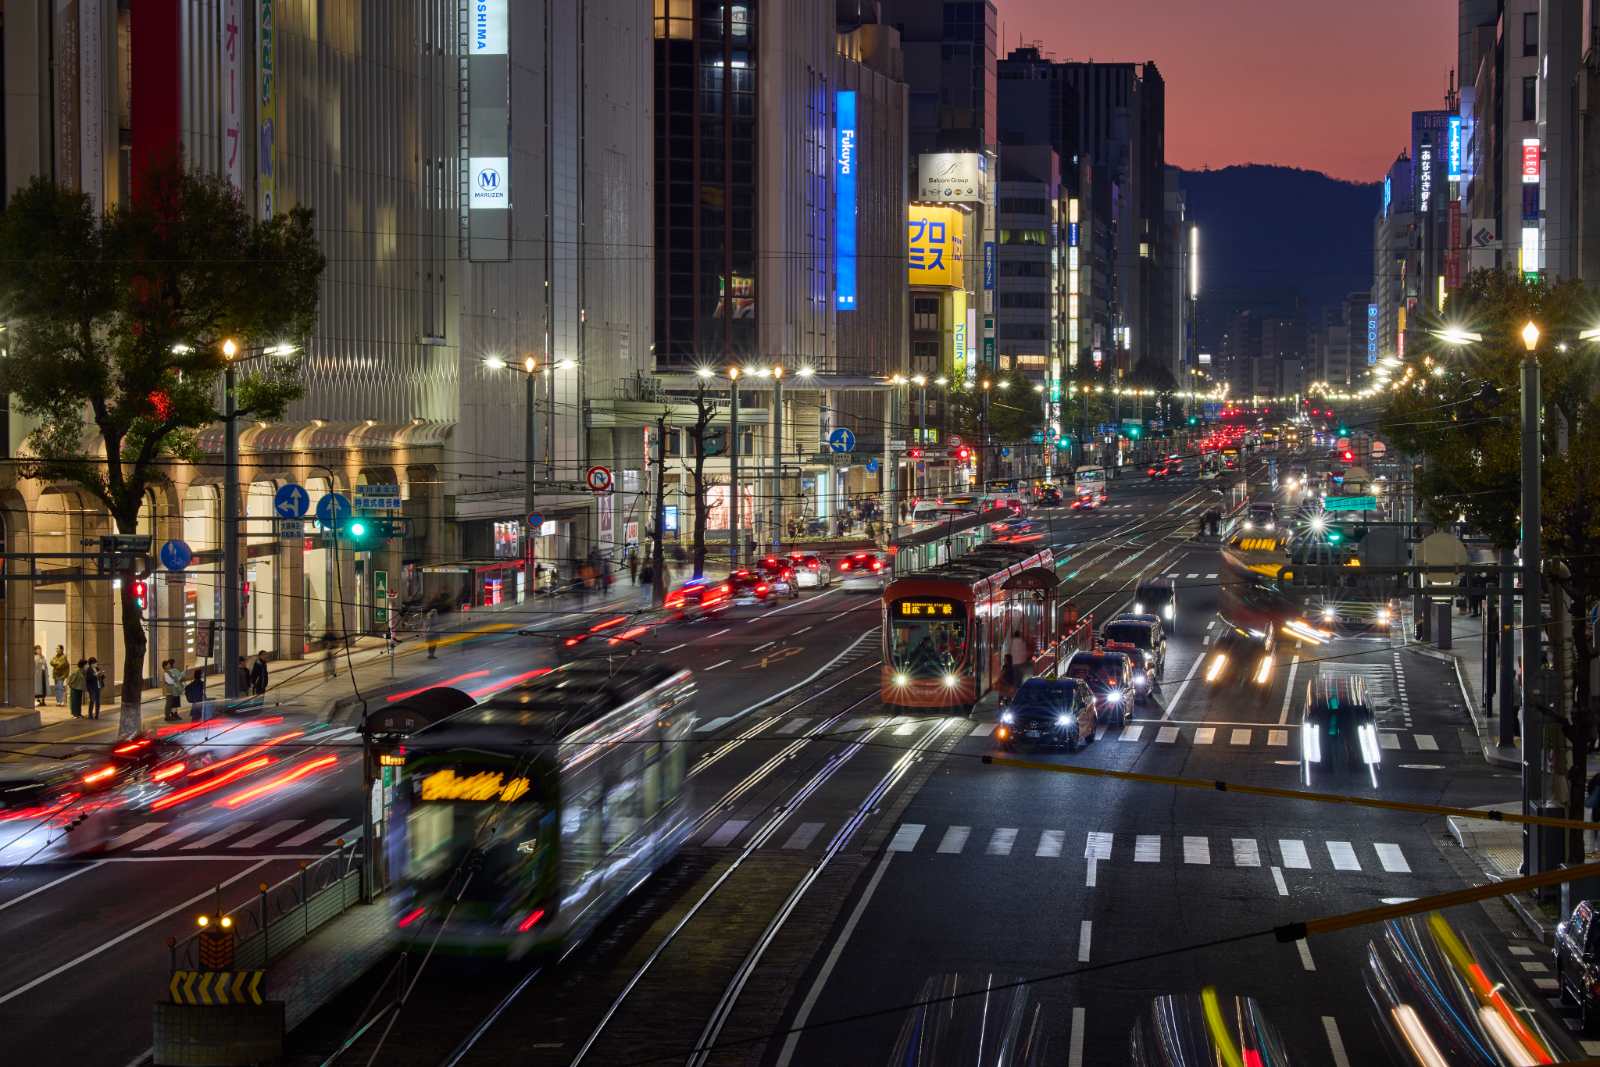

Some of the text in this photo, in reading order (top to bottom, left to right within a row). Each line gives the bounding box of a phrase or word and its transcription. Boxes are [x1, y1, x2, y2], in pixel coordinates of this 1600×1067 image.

[838, 129, 854, 175] Fukuya
[909, 218, 945, 244] プロ
[909, 247, 945, 270] ミス
[955, 323, 964, 360] プロミス
